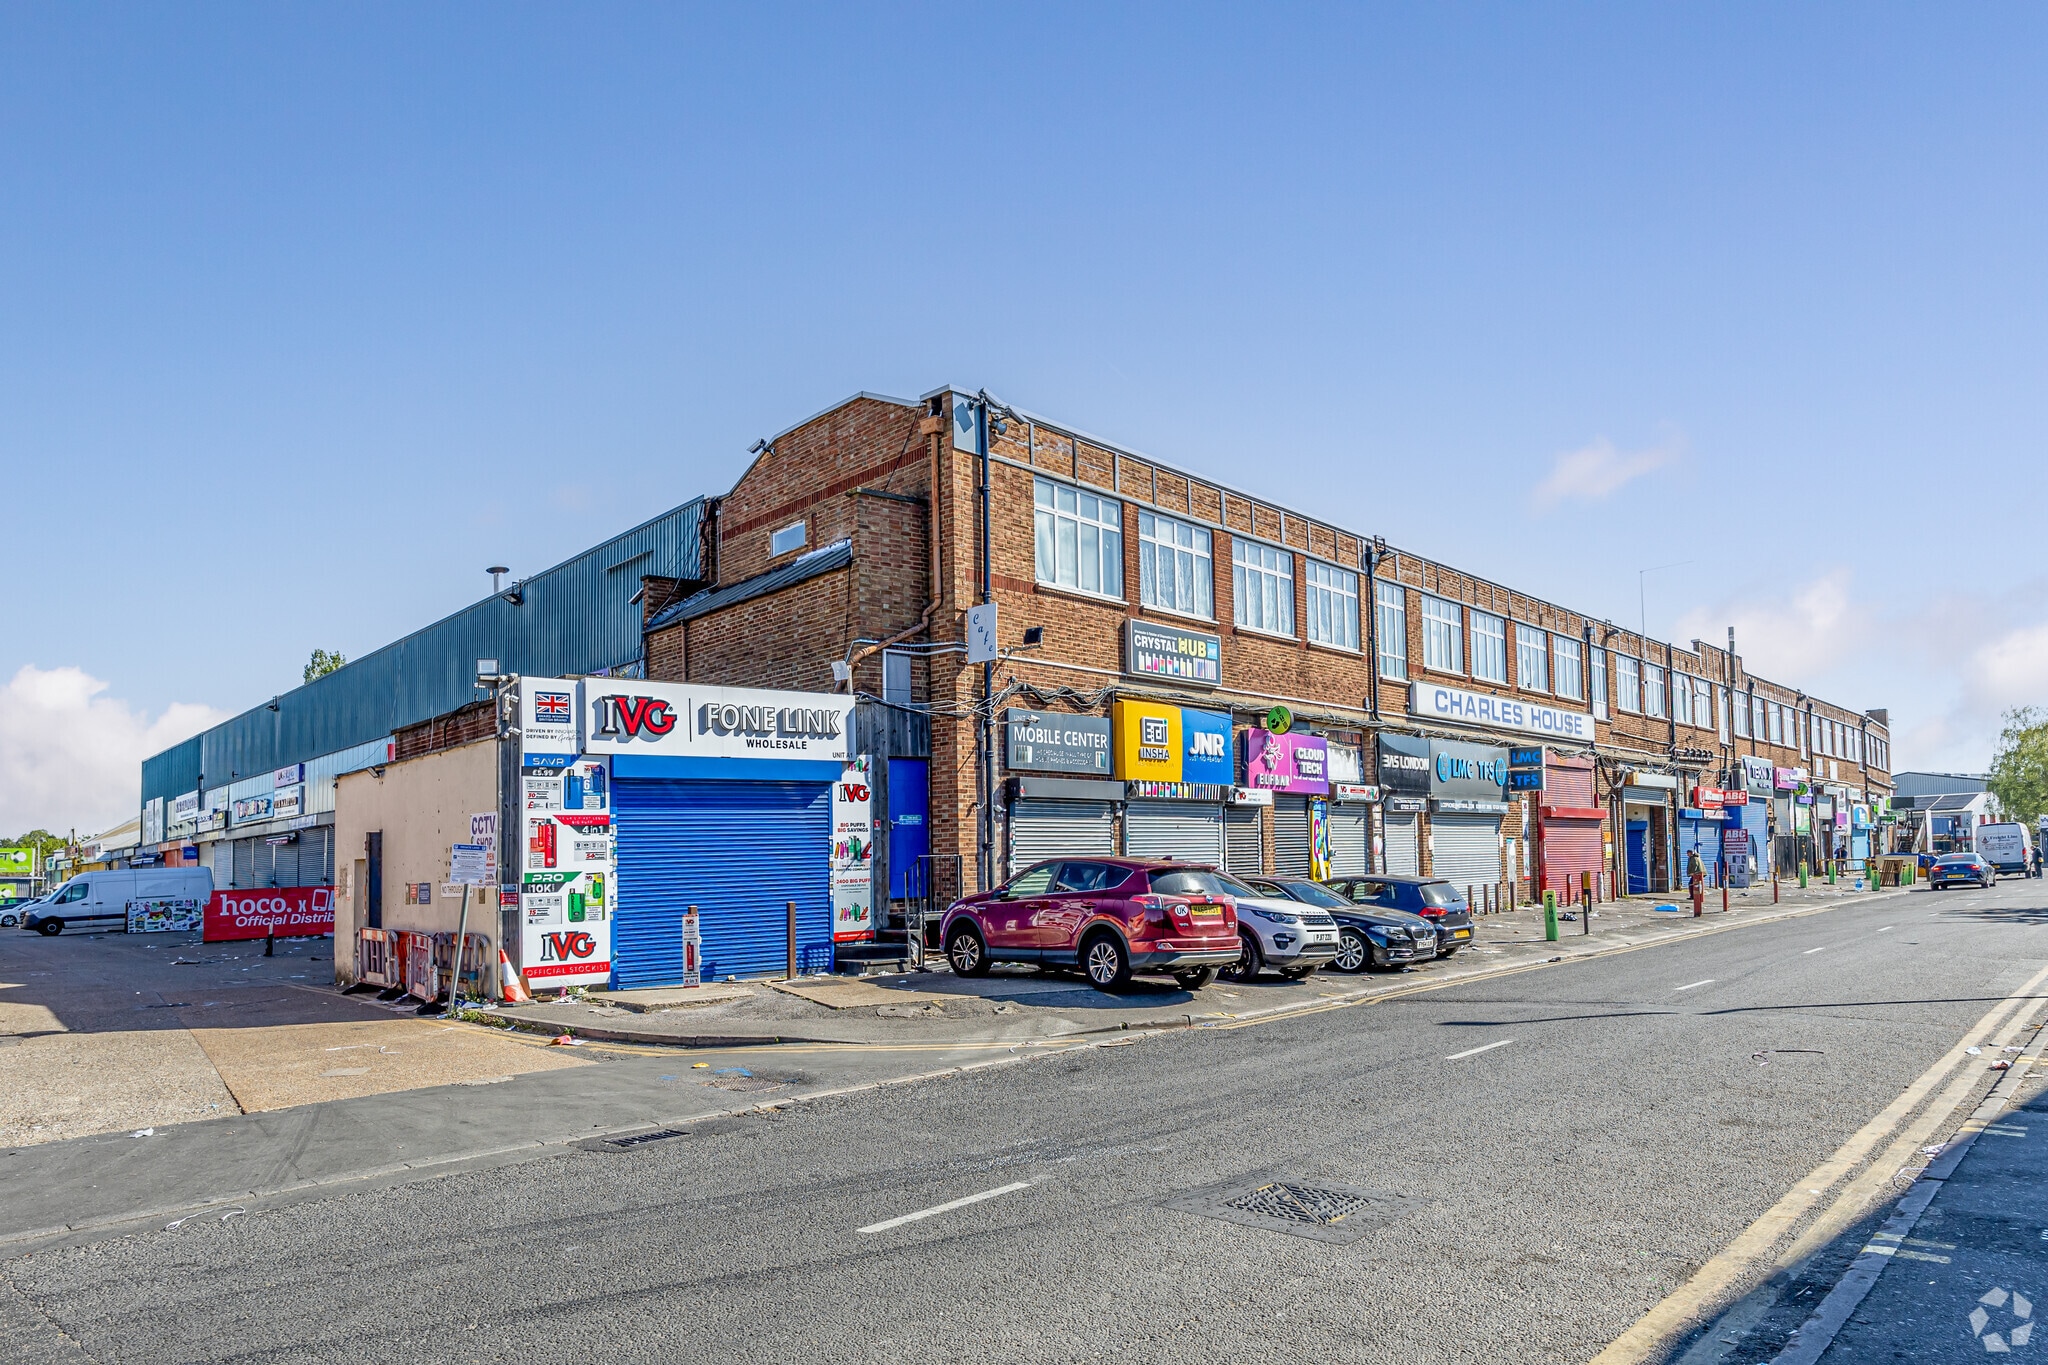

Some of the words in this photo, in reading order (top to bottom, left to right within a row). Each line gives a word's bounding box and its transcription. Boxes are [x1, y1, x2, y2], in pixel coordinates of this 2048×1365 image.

[1134, 634, 1178, 653] CRYSTAL
[601, 694, 678, 736] IVG
[706, 703, 776, 732] FONE
[783, 707, 842, 735] LINK
[1435, 690, 1523, 725] CHARLES
[1531, 707, 1583, 735] HOUSE
[746, 739, 807, 750] WHOLESALE
[1014, 726, 1061, 745] MOBILE
[1064, 730, 1108, 749] CENTER
[1190, 731, 1225, 757] JNR
[1142, 747, 1170, 760] INSHA
[1298, 747, 1325, 761] CLOUD
[1512, 751, 1541, 763] LMC
[1301, 762, 1322, 774] TECH
[1400, 755, 1430, 770] LONDON
[1451, 758, 1474, 779] LMC
[1477, 760, 1495, 780] TFS
[1515, 775, 1539, 787] TFS
[839, 784, 870, 802] IVG
[1725, 791, 1746, 800] ABC
[471, 815, 496, 835] CCTV
[1725, 830, 1746, 838] ABC
[532, 873, 565, 882] PRO
[531, 883, 552, 893] 10K
[220, 894, 292, 916] hoco.
[298, 900, 307, 912] x
[1177, 906, 1186, 914] UK
[235, 914, 288, 927] Official
[290, 912, 335, 925] Distrib
[540, 931, 597, 961] IVG
[526, 967, 567, 977] OFFICIAL
[569, 964, 608, 973] STOCKIST
